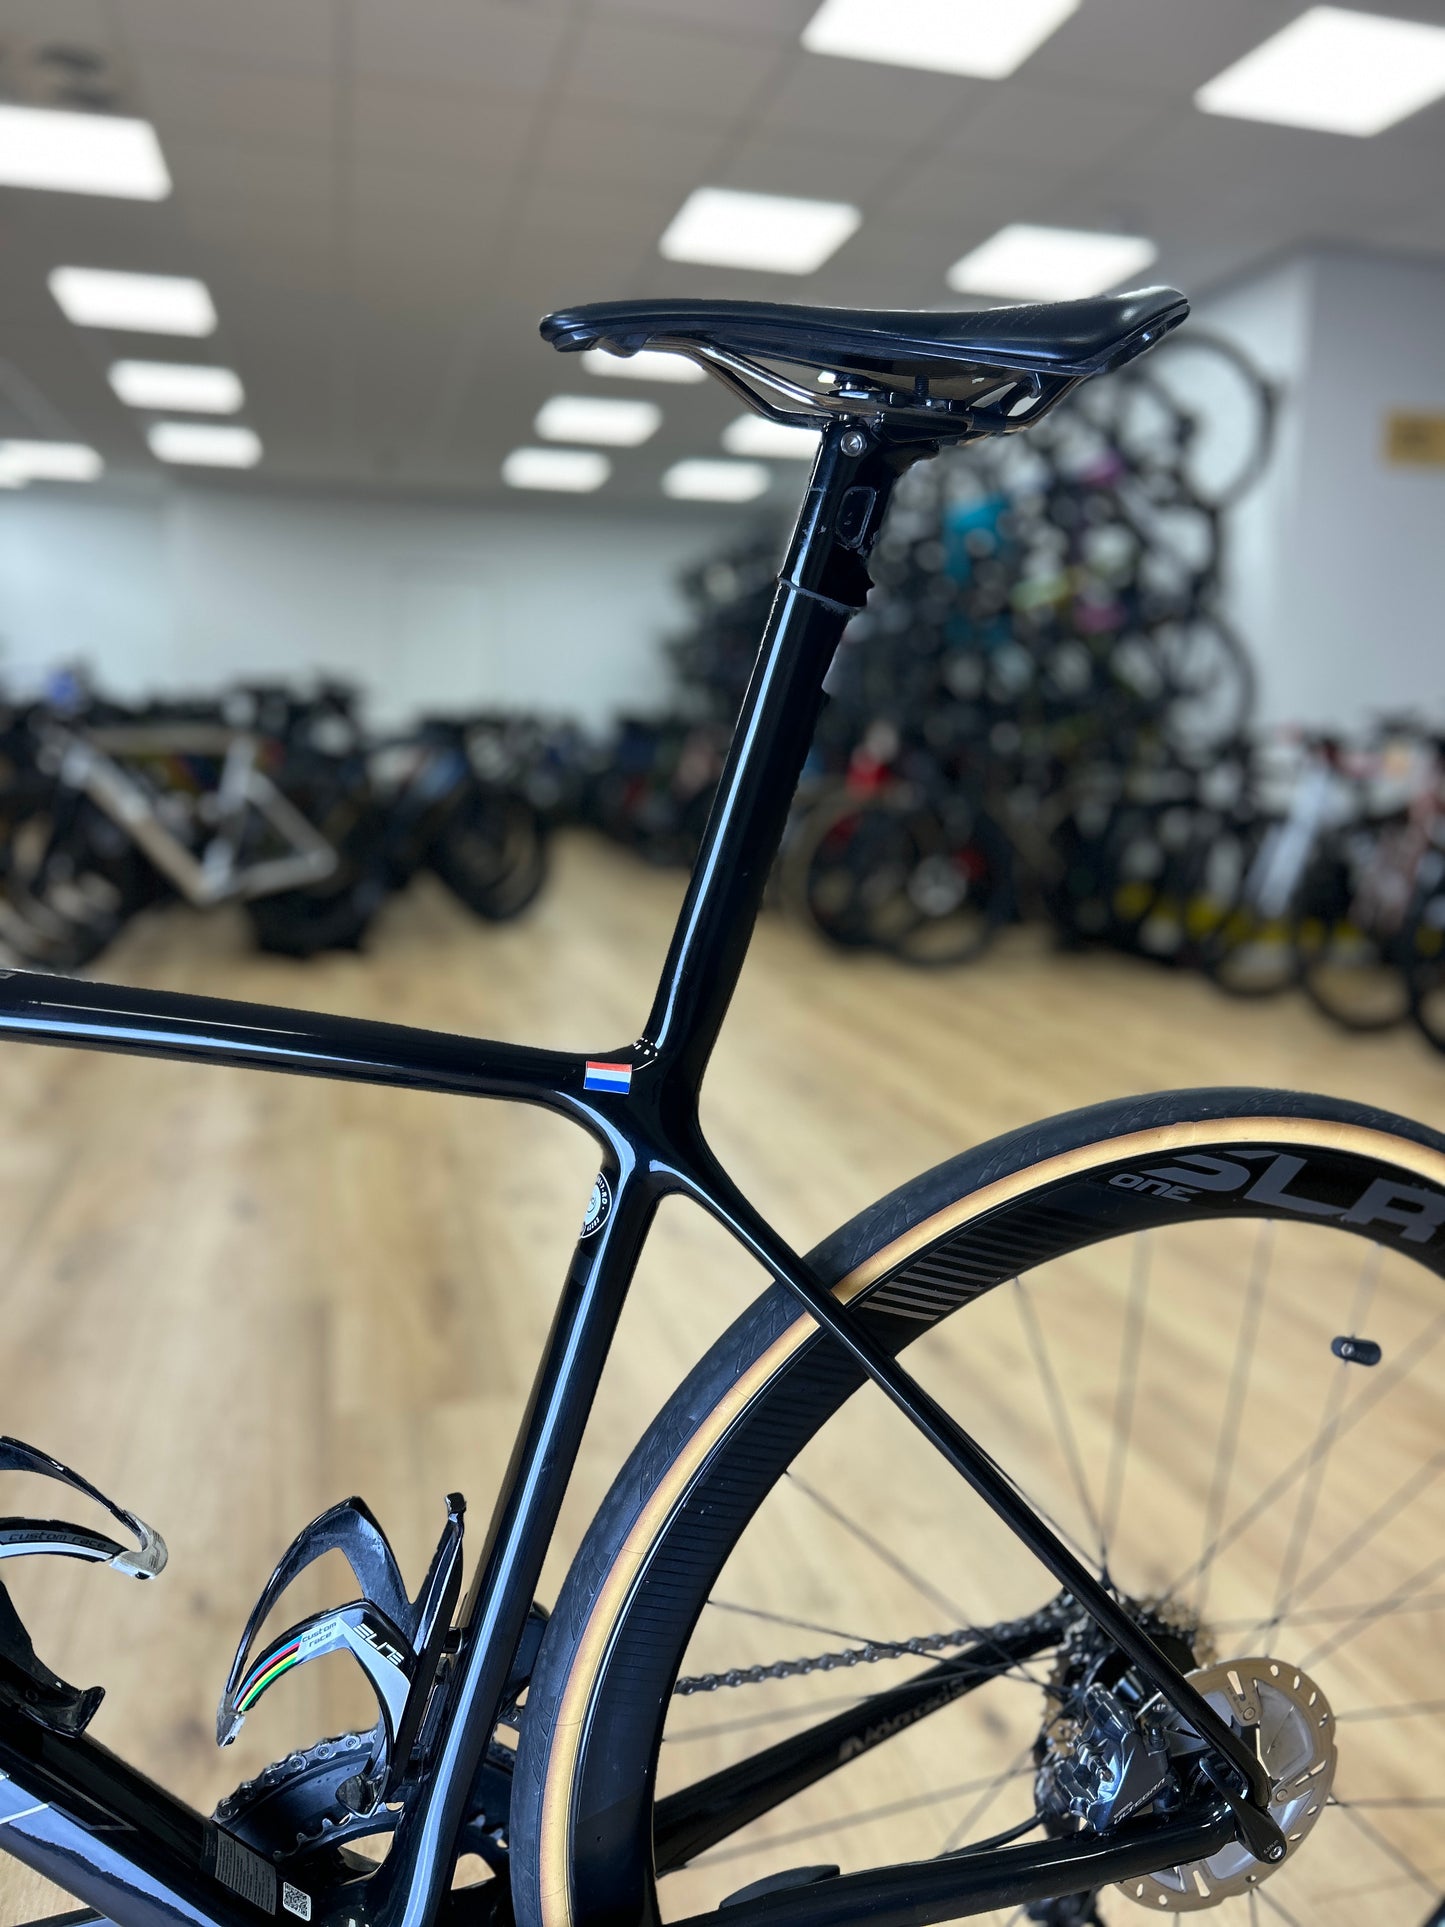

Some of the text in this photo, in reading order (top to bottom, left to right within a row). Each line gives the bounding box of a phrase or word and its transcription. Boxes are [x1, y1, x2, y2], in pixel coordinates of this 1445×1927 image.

[1139, 1149, 1445, 1244] SLR
[8, 1531, 107, 1549] custom race
[302, 1621, 338, 1643] custom
[308, 1631, 333, 1648] race
[353, 1622, 405, 1666] ELITE
[1113, 1777, 1166, 1825] ULTEGRA
